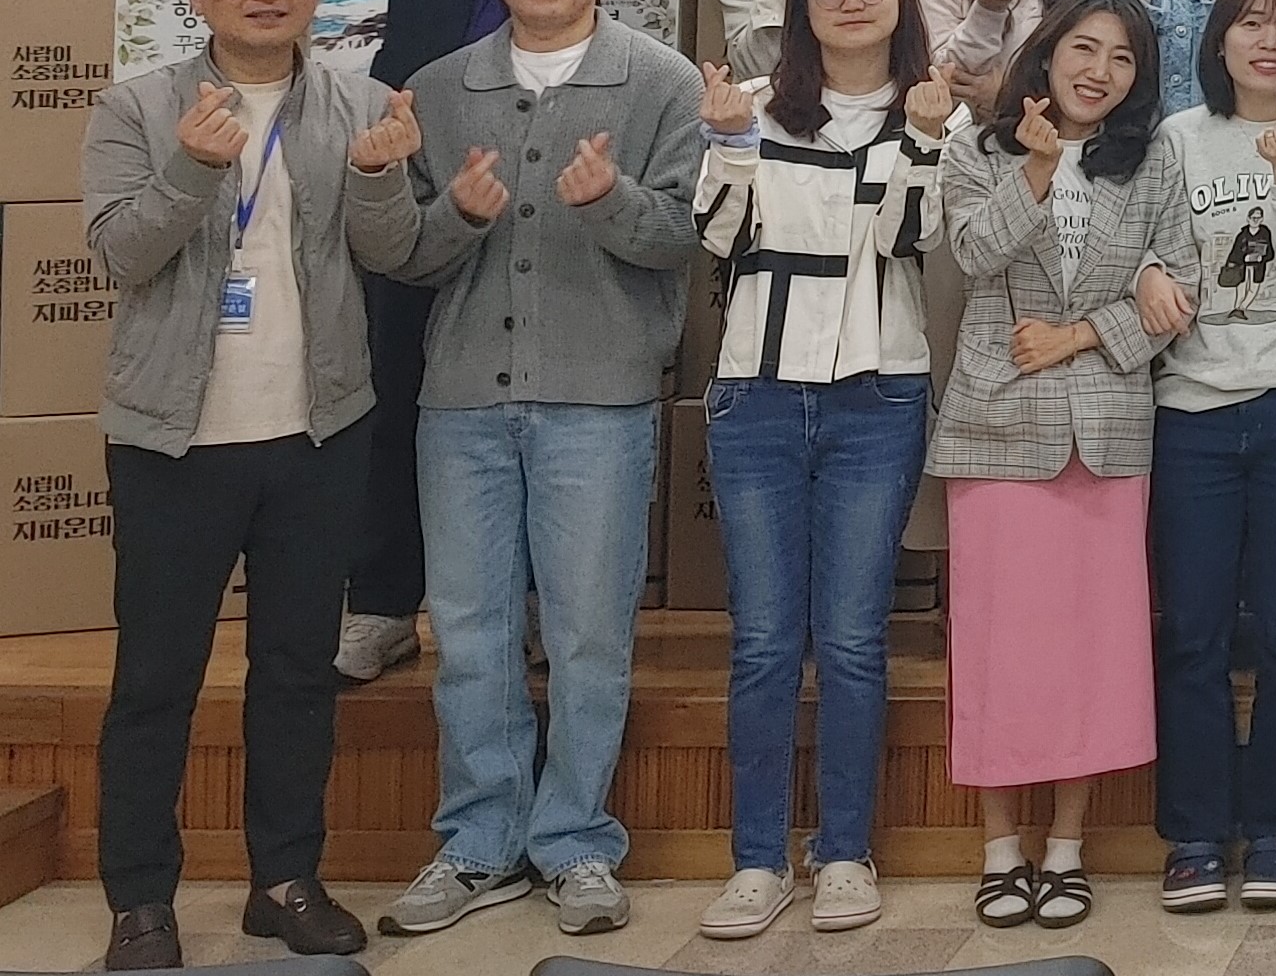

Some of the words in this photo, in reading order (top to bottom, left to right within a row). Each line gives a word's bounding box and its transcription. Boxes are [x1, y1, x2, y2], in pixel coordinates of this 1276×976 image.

[12, 46, 71, 63] 사람이
[1190, 173, 1273, 215] OLIV
[33, 258, 92, 276] 사람이
[13, 473, 73, 494] 사람이
[12, 515, 112, 541] 지파운데
